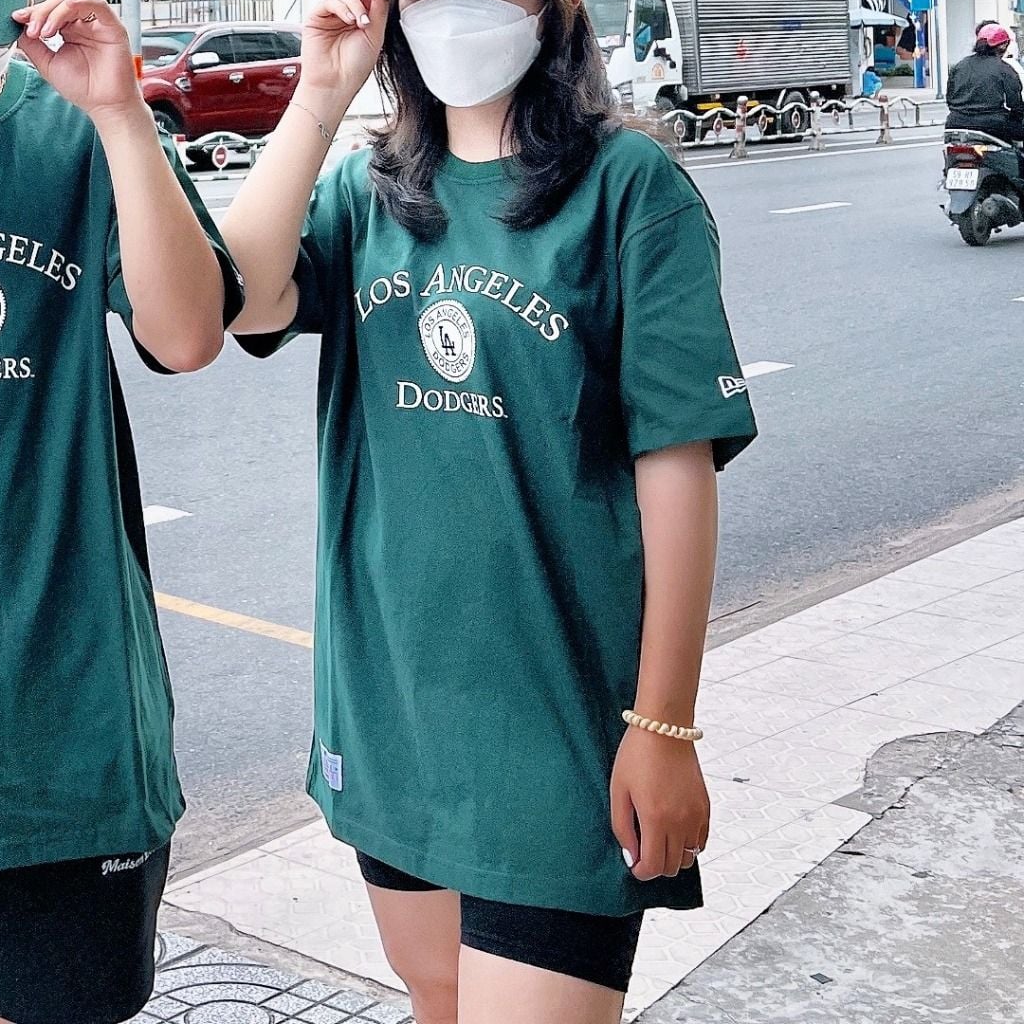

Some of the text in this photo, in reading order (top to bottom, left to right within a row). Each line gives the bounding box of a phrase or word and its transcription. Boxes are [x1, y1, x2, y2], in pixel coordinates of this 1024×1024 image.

[354, 263, 570, 342] LOS ANGELES
[424, 308, 469, 339] LOS ANGELES
[438, 325, 457, 356] LA
[432, 352, 469, 374] DODGERS
[396, 380, 505, 419] DODGERS
